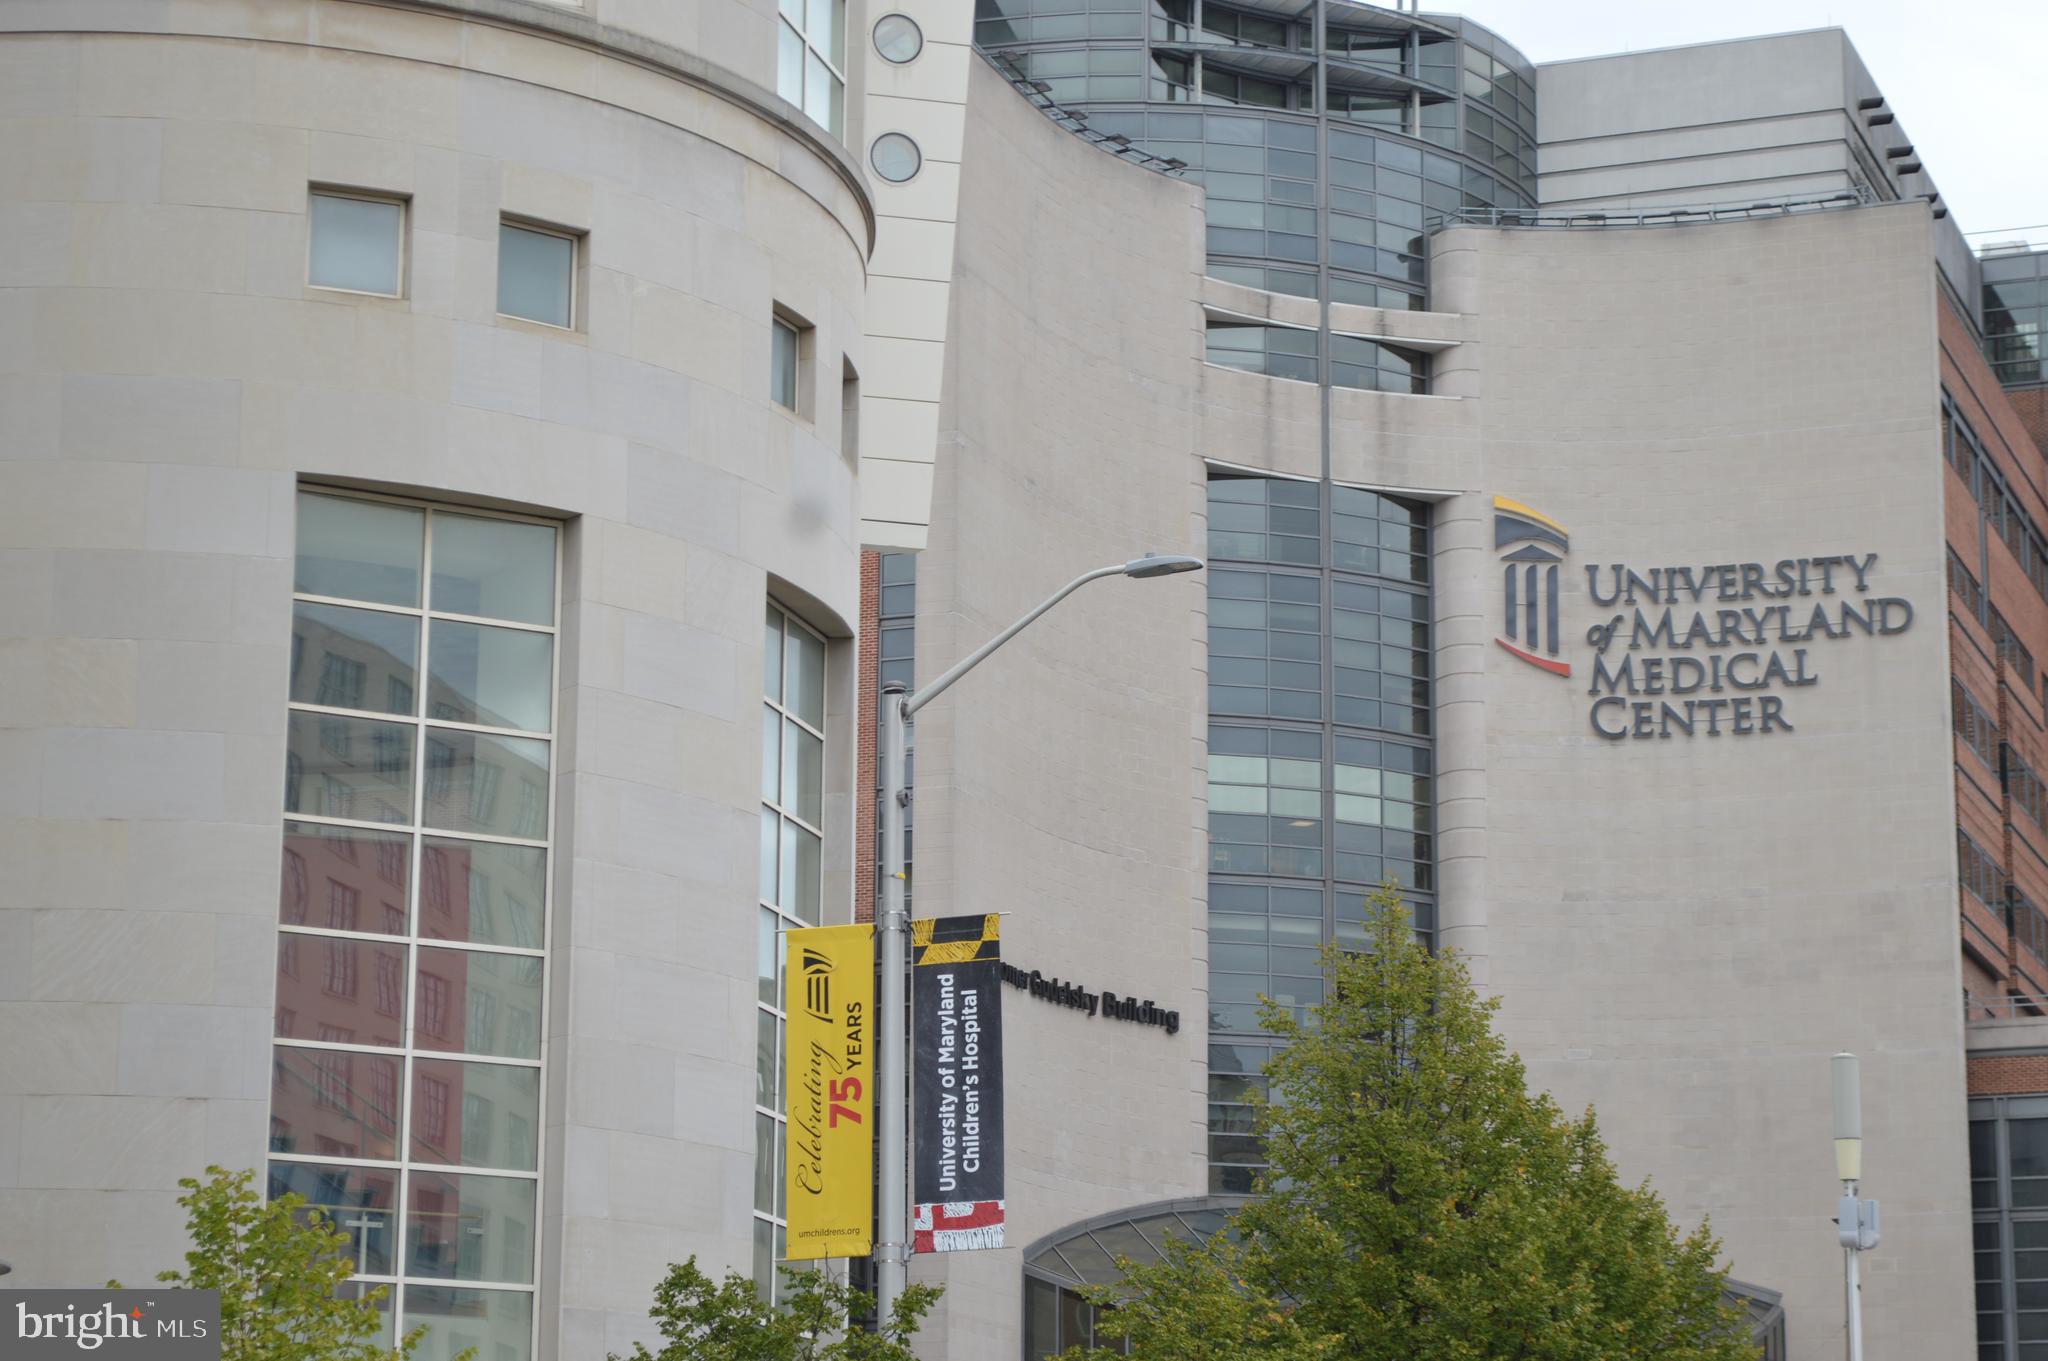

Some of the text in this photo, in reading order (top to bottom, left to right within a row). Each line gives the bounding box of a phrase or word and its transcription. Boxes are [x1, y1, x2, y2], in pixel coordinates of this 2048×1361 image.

[1585, 553, 1878, 606] UNIVERSITY
[1586, 597, 1915, 654] of MARYLAND
[1587, 648, 1819, 696] MEDICAL
[1589, 695, 1794, 740] CENTER
[962, 989, 980, 1070] Hospital
[1029, 969, 1099, 1018] Gudelsky
[1102, 991, 1180, 1034] Building
[829, 1001, 862, 1128] 75 YEARS
[937, 973, 958, 1192] University of Maryland
[793, 1039, 842, 1195] Celebrating
[798, 1227, 860, 1238] umchildrens.org
